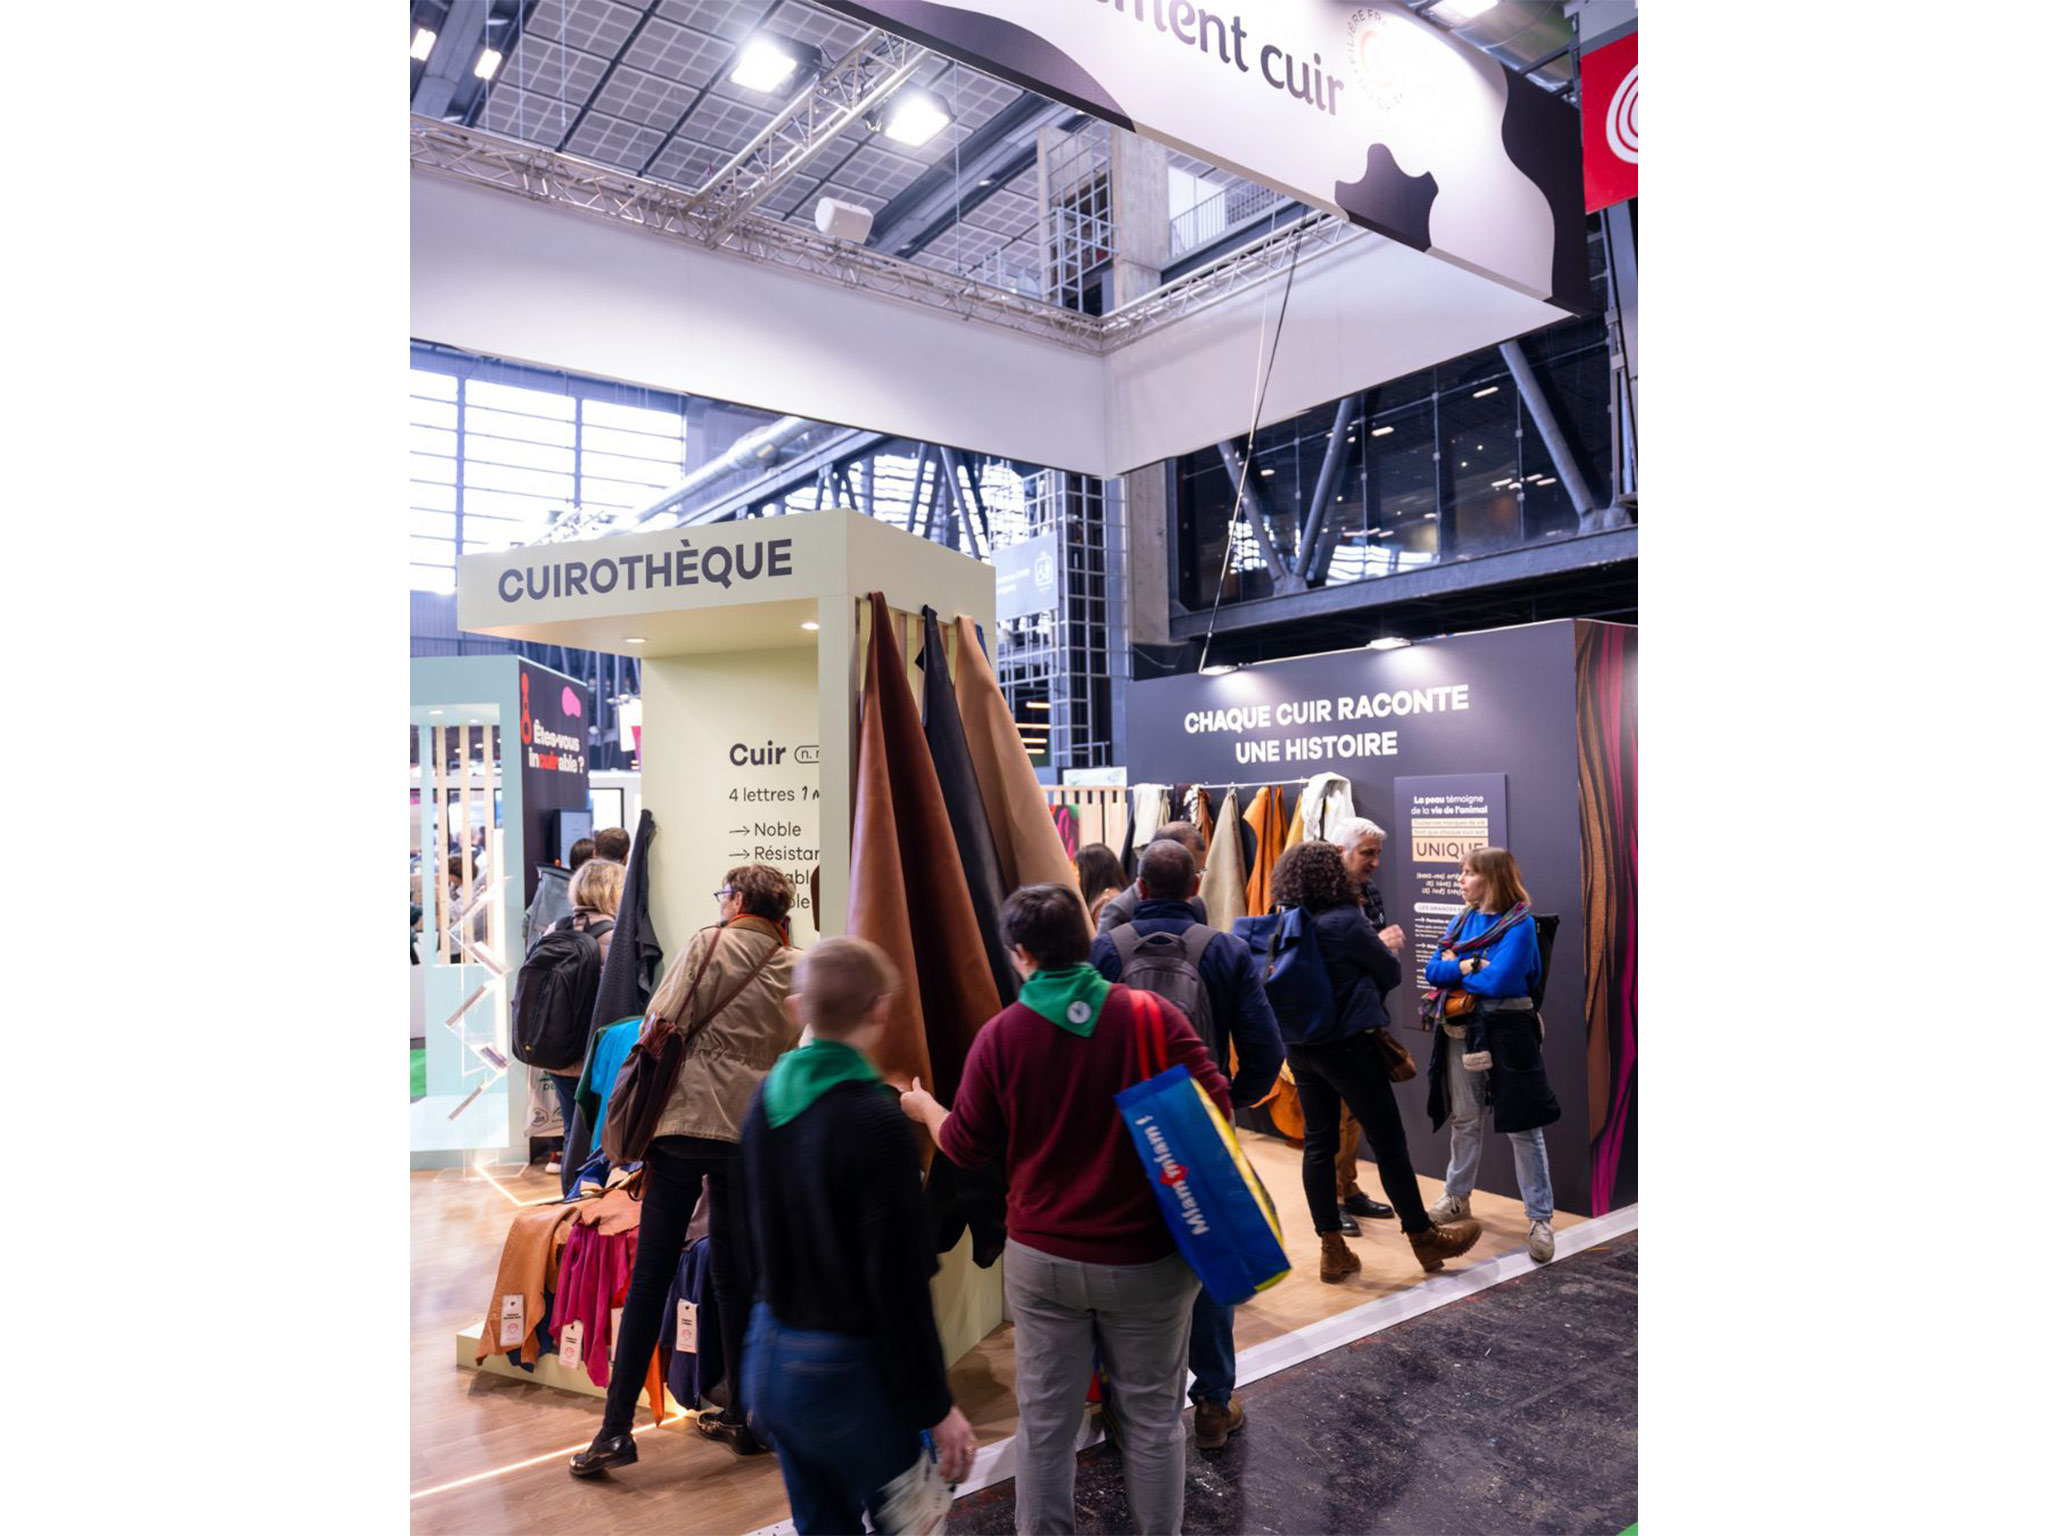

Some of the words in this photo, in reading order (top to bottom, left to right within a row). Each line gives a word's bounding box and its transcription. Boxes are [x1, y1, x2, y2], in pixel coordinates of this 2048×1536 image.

[1260, 44, 1345, 116] cuir
[498, 538, 793, 603] CUIROTHÈQUE
[1184, 705, 1271, 734] CHAQUE
[1276, 699, 1332, 726] CUIR
[1338, 684, 1470, 720] RACONTE
[729, 740, 787, 766] Cuir
[1235, 739, 1280, 764] UNE
[1286, 731, 1398, 761] HISTOIRE
[729, 787, 739, 802] 4
[743, 786, 795, 802] lettres
[1411, 806, 1421, 815] de
[1422, 806, 1430, 815] la
[1430, 805, 1443, 814] vie
[1444, 805, 1454, 814] de
[1413, 795, 1424, 804] La
[1425, 796, 1445, 805] peau
[1446, 794, 1484, 804] témoigne
[754, 821, 801, 837] Noble
[1144, 1125, 1181, 1178] miam
[1172, 1179, 1210, 1235] Miam
